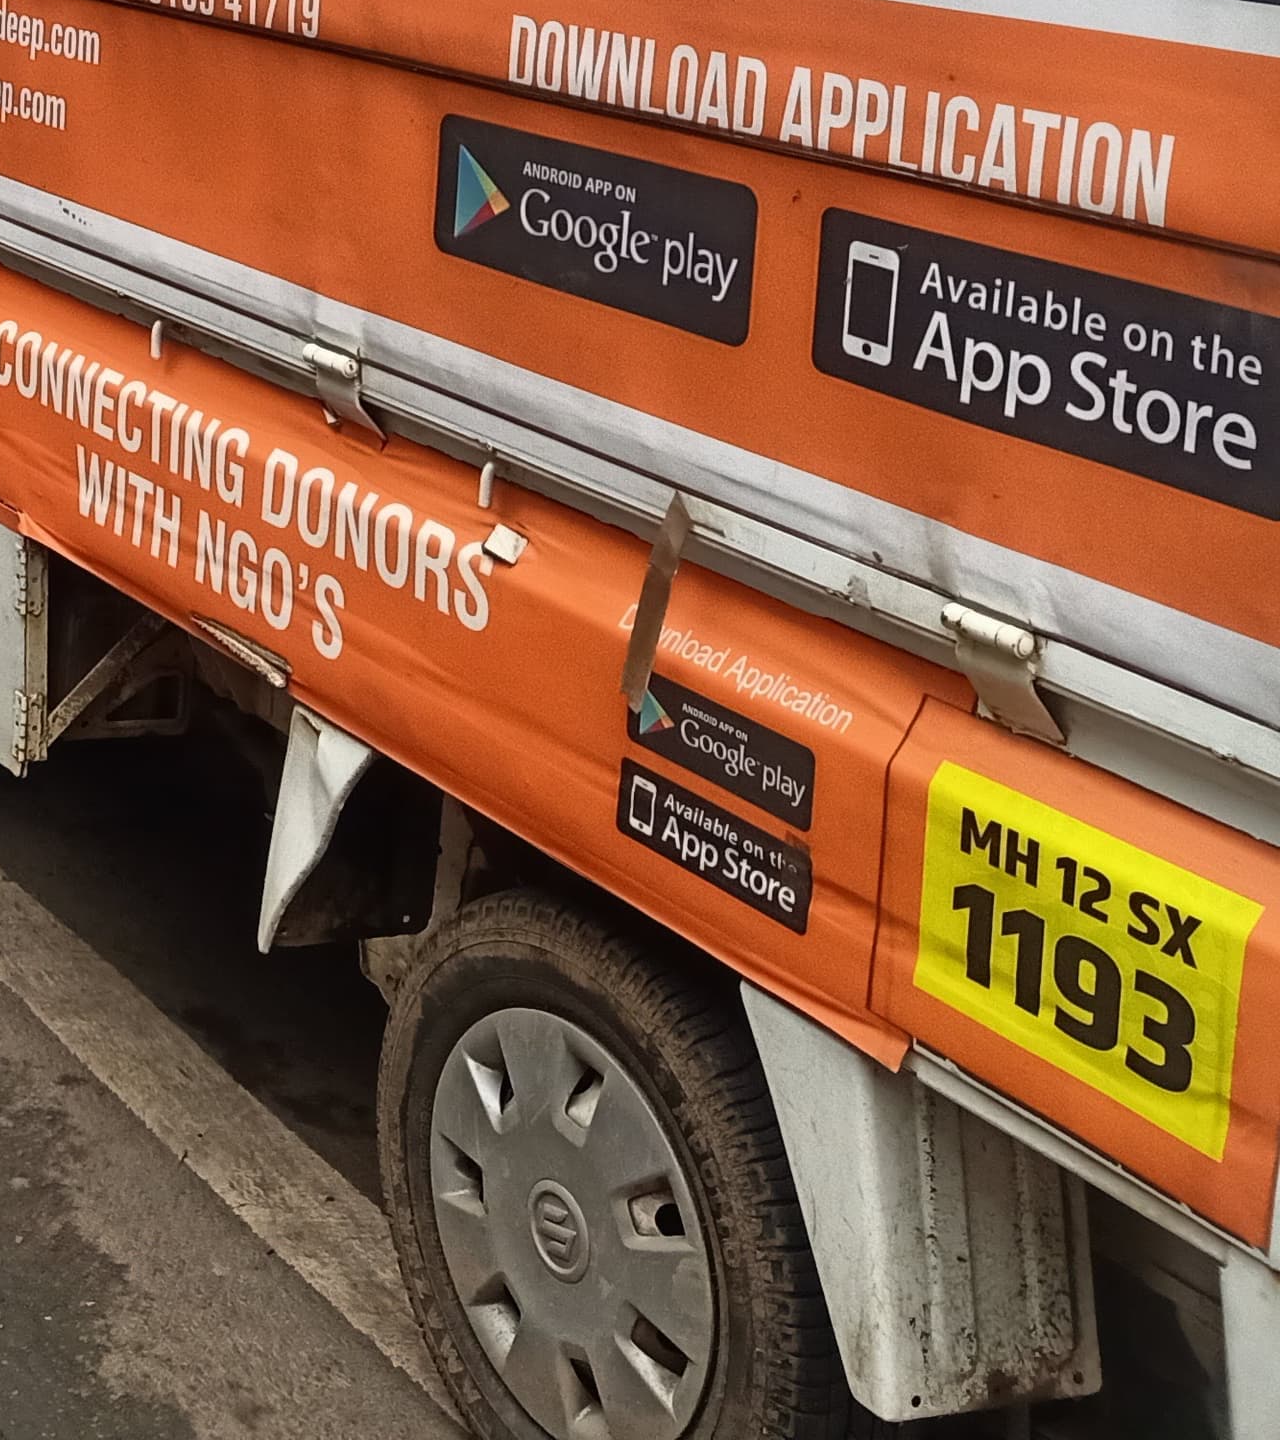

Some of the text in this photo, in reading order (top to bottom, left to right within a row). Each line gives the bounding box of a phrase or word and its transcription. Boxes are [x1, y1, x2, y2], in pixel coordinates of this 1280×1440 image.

[508, 14, 1176, 228] DOWNLOAD APPLICATION
[522, 161, 636, 203] ANDROID APP ON
[520, 188, 738, 302] Google play
[920, 262, 1262, 386] Available on the
[913, 311, 1258, 471] App Store
[76, 443, 345, 660] WITH NGO'S
[262, 447, 494, 632] DONORS
[682, 703, 748, 742] ANDROID APP ON
[723, 655, 854, 735] Application
[680, 718, 805, 807] Google play
[661, 816, 796, 913] App Store
[664, 793, 738, 846] Available
[743, 840, 763, 860] on
[960, 807, 1203, 969] MH 12 SX
[952, 883, 1197, 1093] 1193
